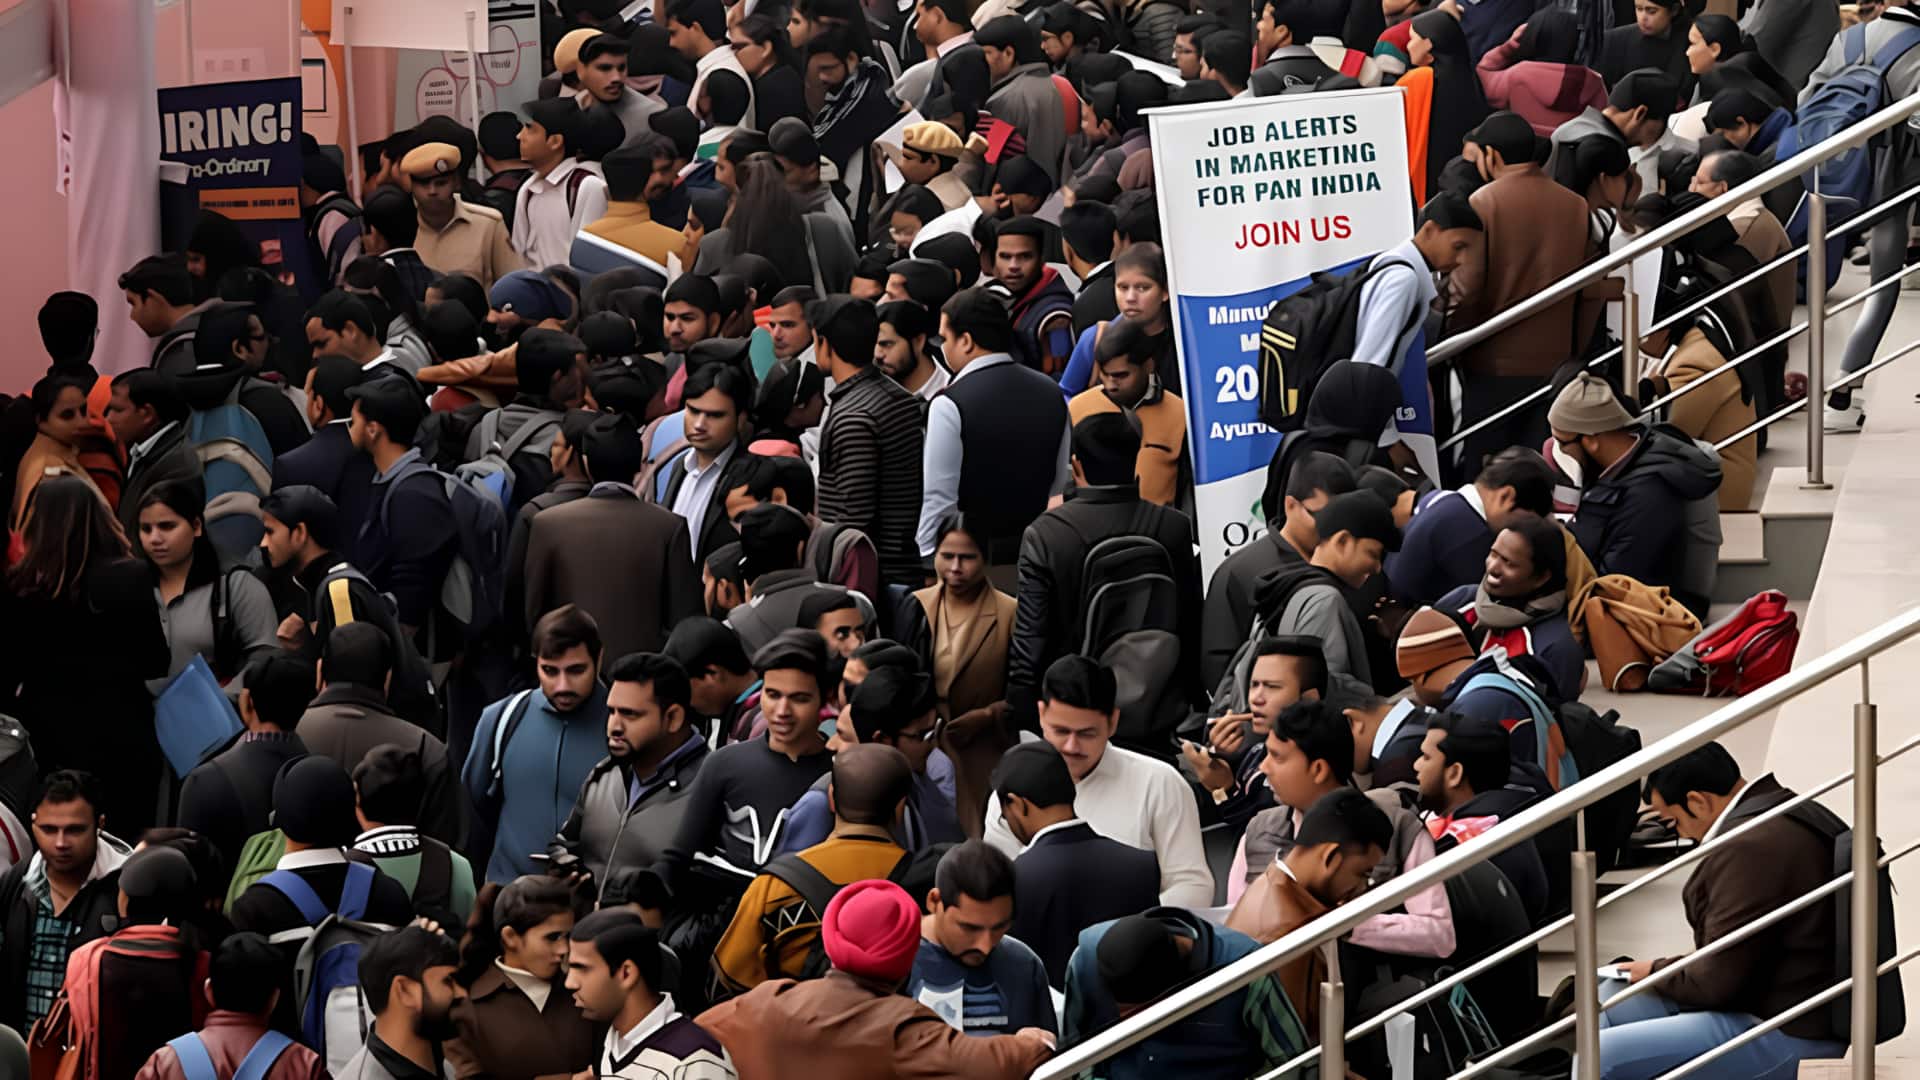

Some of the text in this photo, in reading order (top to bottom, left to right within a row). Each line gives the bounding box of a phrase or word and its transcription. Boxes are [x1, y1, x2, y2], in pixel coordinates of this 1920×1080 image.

[1208, 114, 1357, 147] JOB ALERTS
[1195, 142, 1376, 178] IN MARKETING
[1197, 171, 1381, 208] FOR PAN INDIA
[1235, 215, 1351, 250] JOIN US
